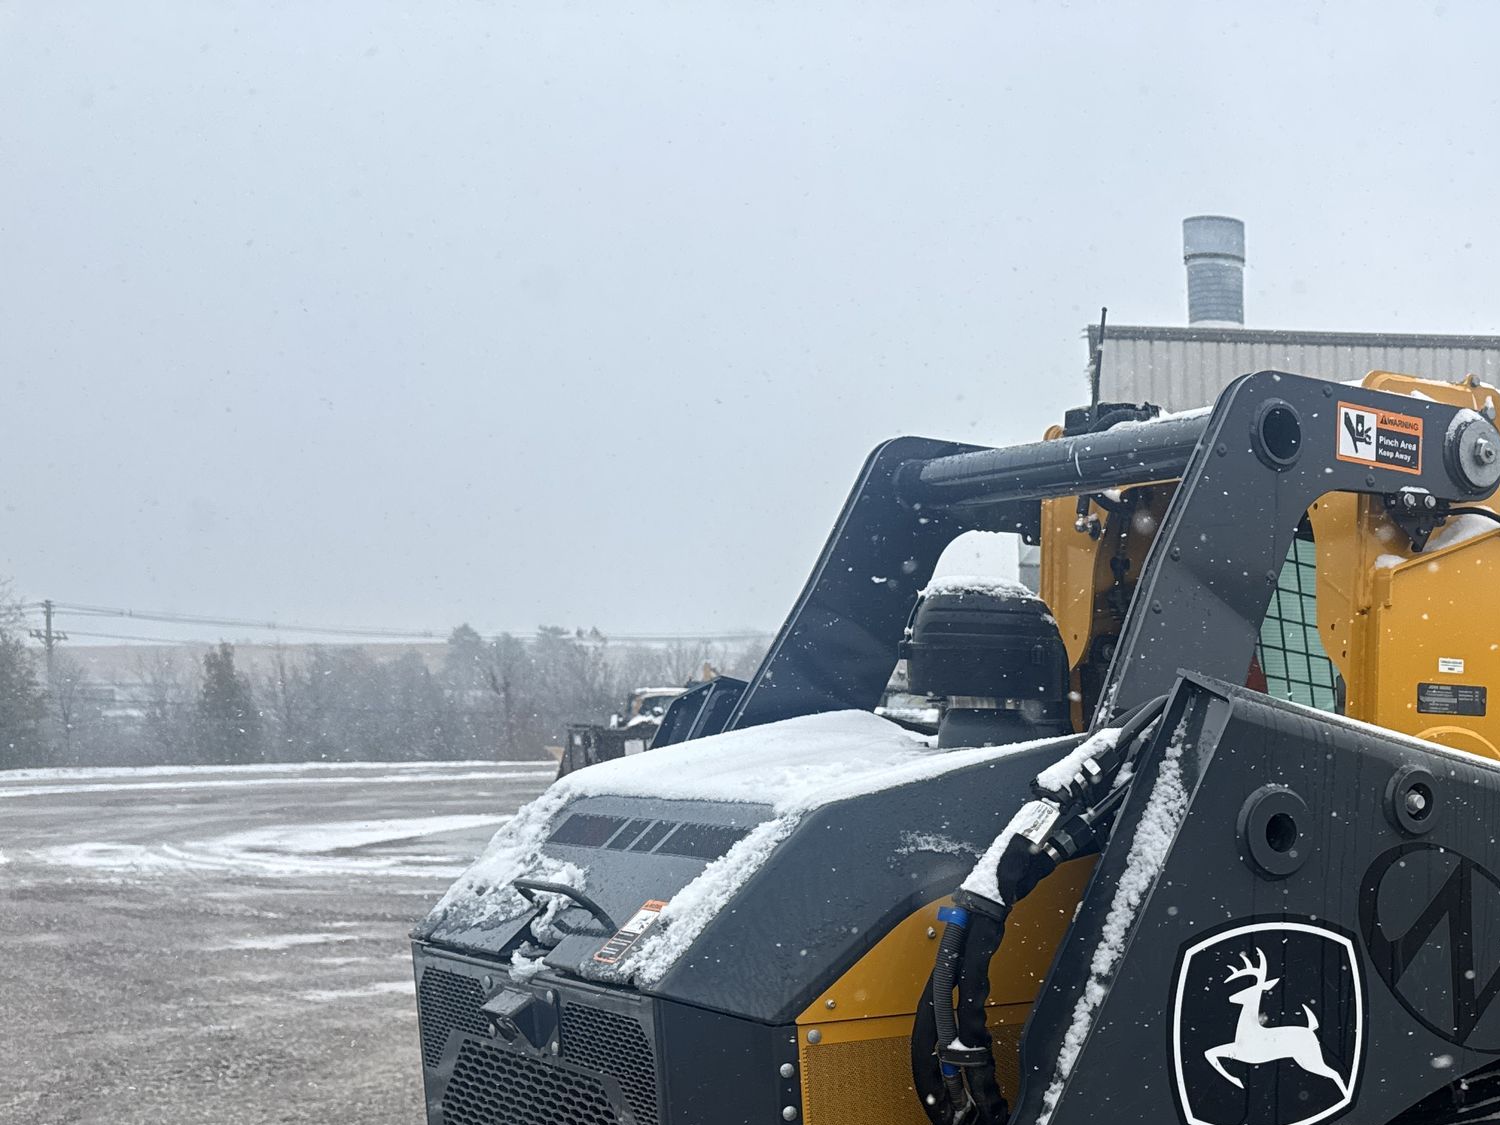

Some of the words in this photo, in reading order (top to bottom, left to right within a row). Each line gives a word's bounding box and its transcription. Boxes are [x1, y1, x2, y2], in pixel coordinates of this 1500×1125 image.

[1387, 419, 1419, 431] WARNING
[1379, 435, 1399, 447] Pinch
[1400, 440, 1417, 451] Area
[1378, 448, 1394, 459] Keep
[1395, 451, 1411, 462] Away
